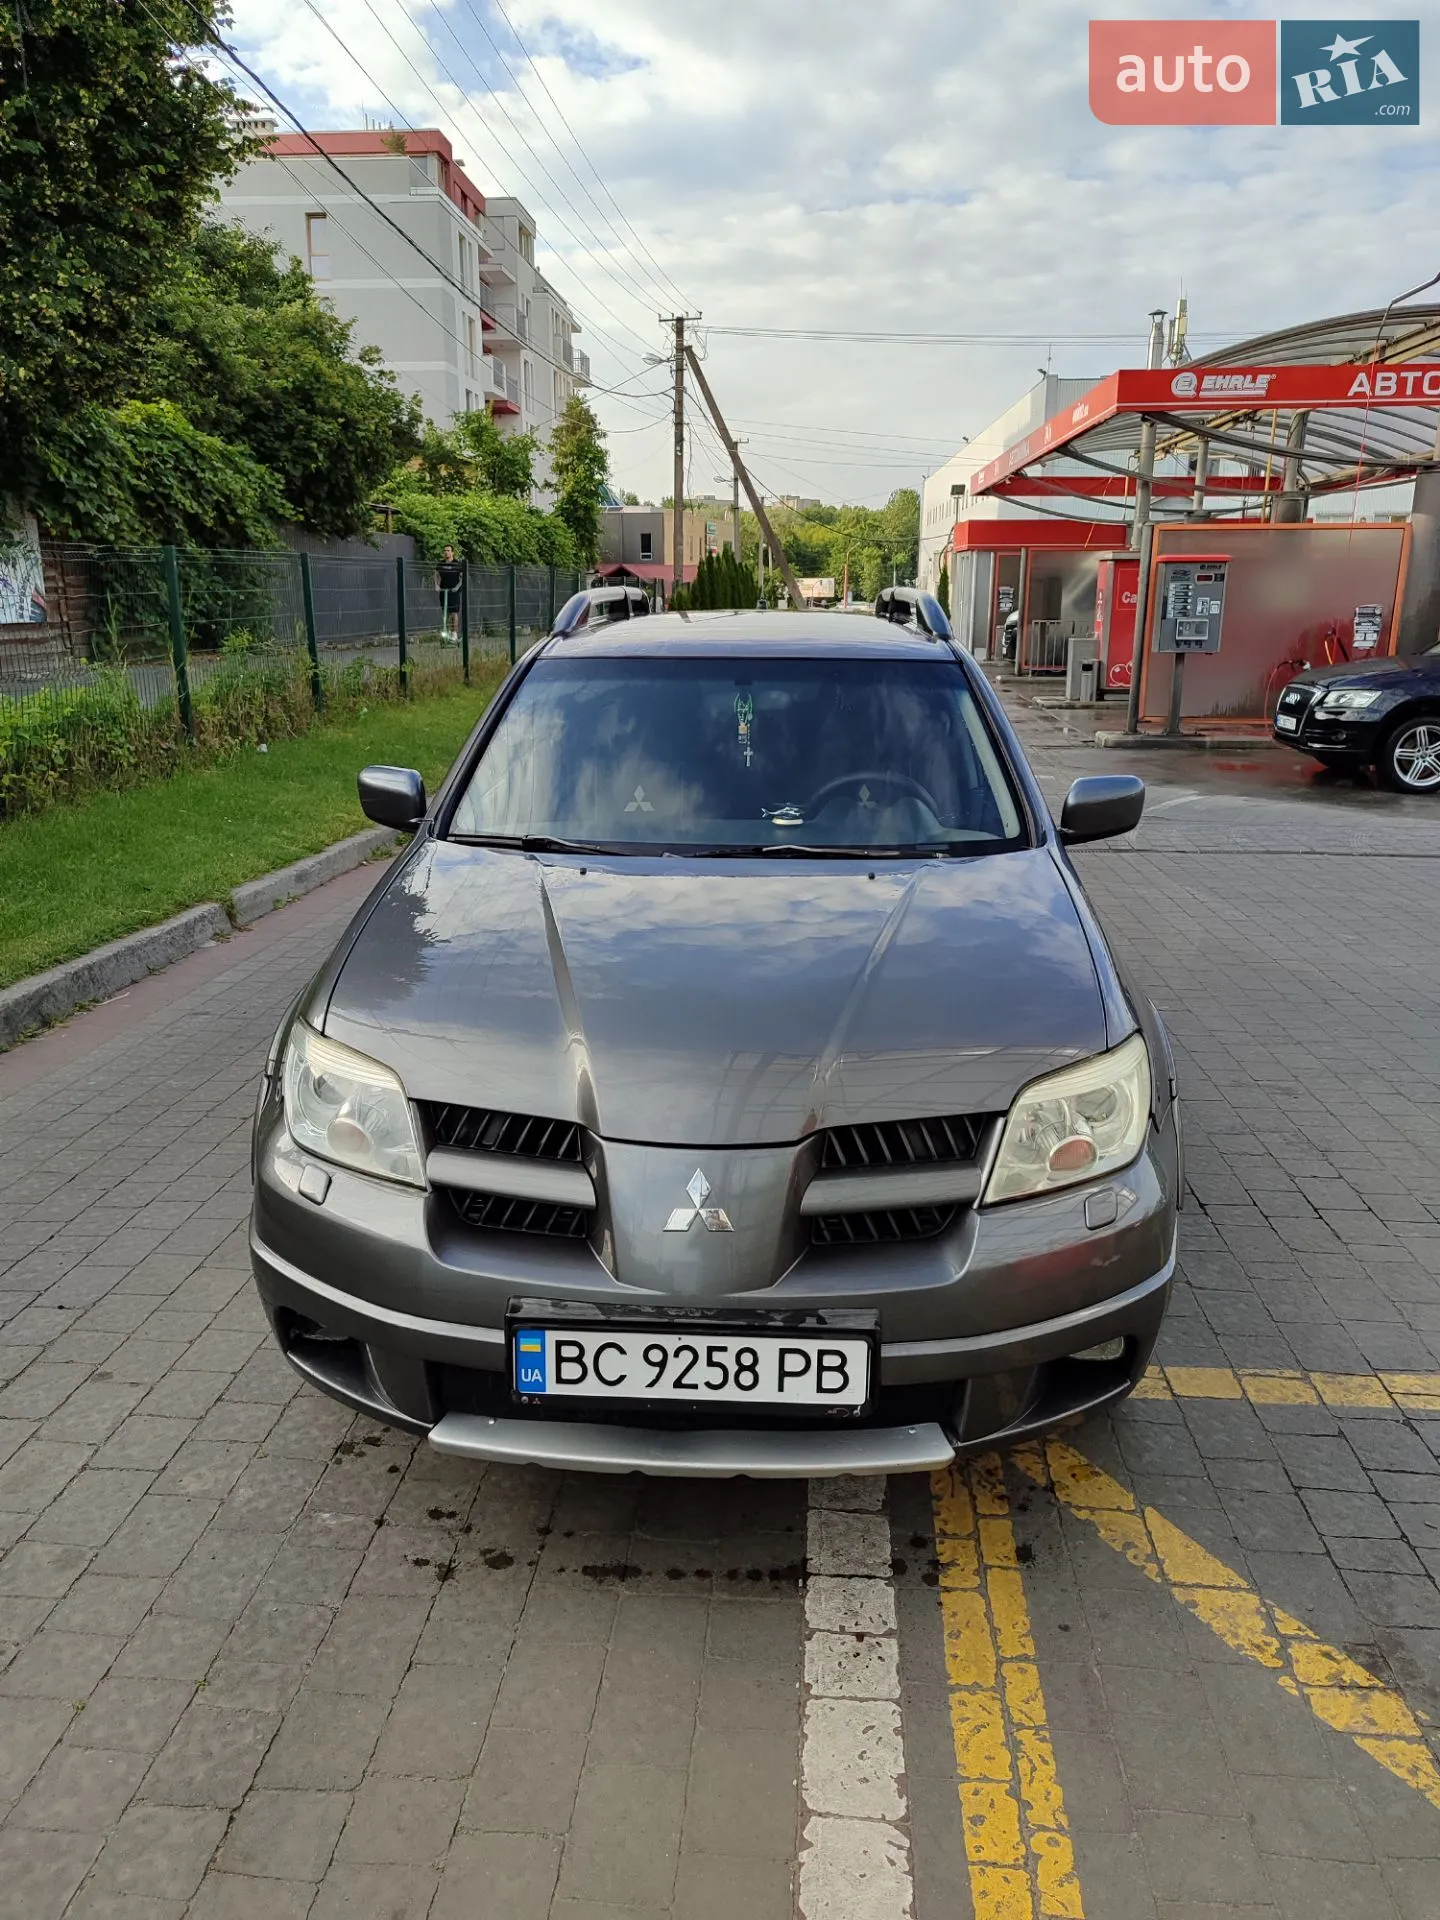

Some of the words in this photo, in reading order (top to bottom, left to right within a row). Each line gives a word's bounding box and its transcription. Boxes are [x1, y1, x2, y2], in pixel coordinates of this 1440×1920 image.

[1201, 374, 1270, 390] EHRLE
[555, 1339, 627, 1387] BC
[642, 1343, 759, 1392] 9258
[778, 1348, 850, 1394] PB
[521, 1368, 543, 1383] UA
